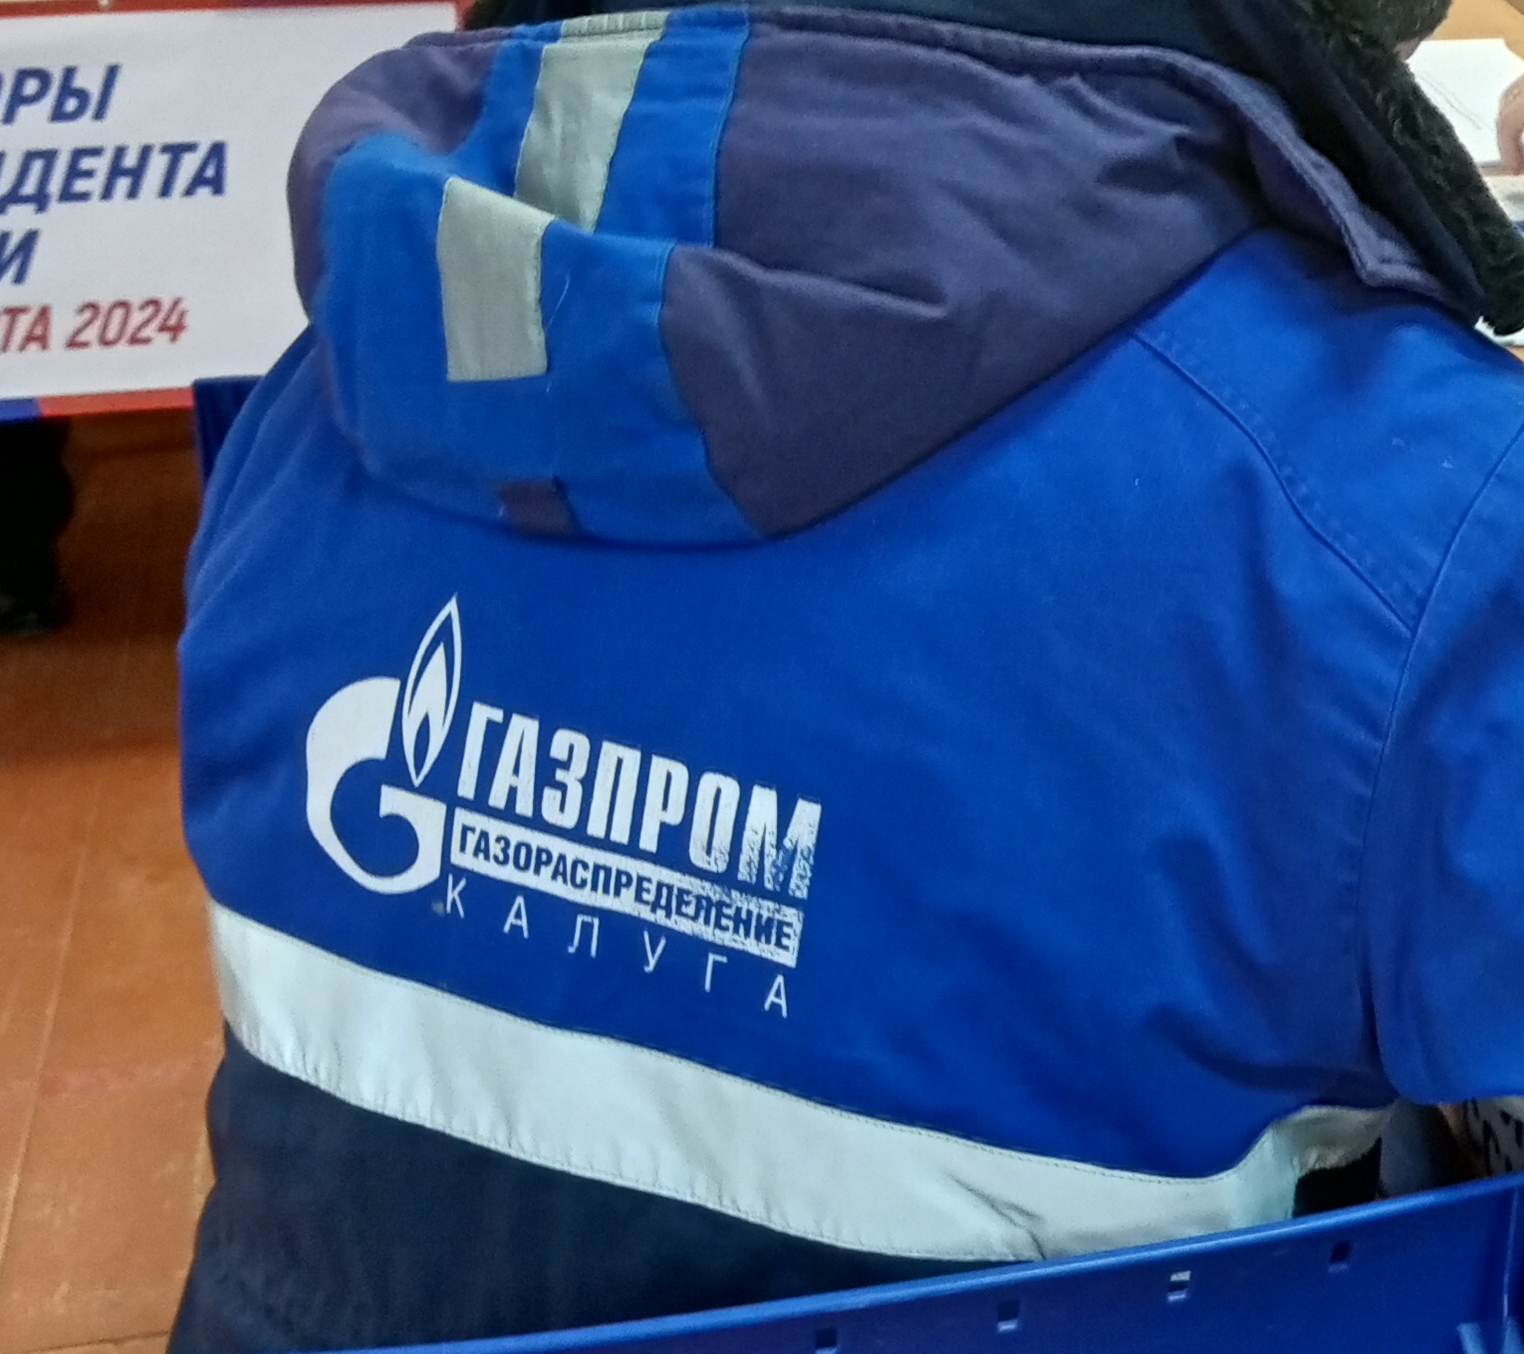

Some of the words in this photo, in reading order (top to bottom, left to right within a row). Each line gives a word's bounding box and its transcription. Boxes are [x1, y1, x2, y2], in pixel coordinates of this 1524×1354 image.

[0, 64, 121, 124] РЫ
[0, 141, 228, 214] ДЕНТА
[65, 297, 190, 351] 2024
[457, 700, 822, 900] ГАЗПРОМ
